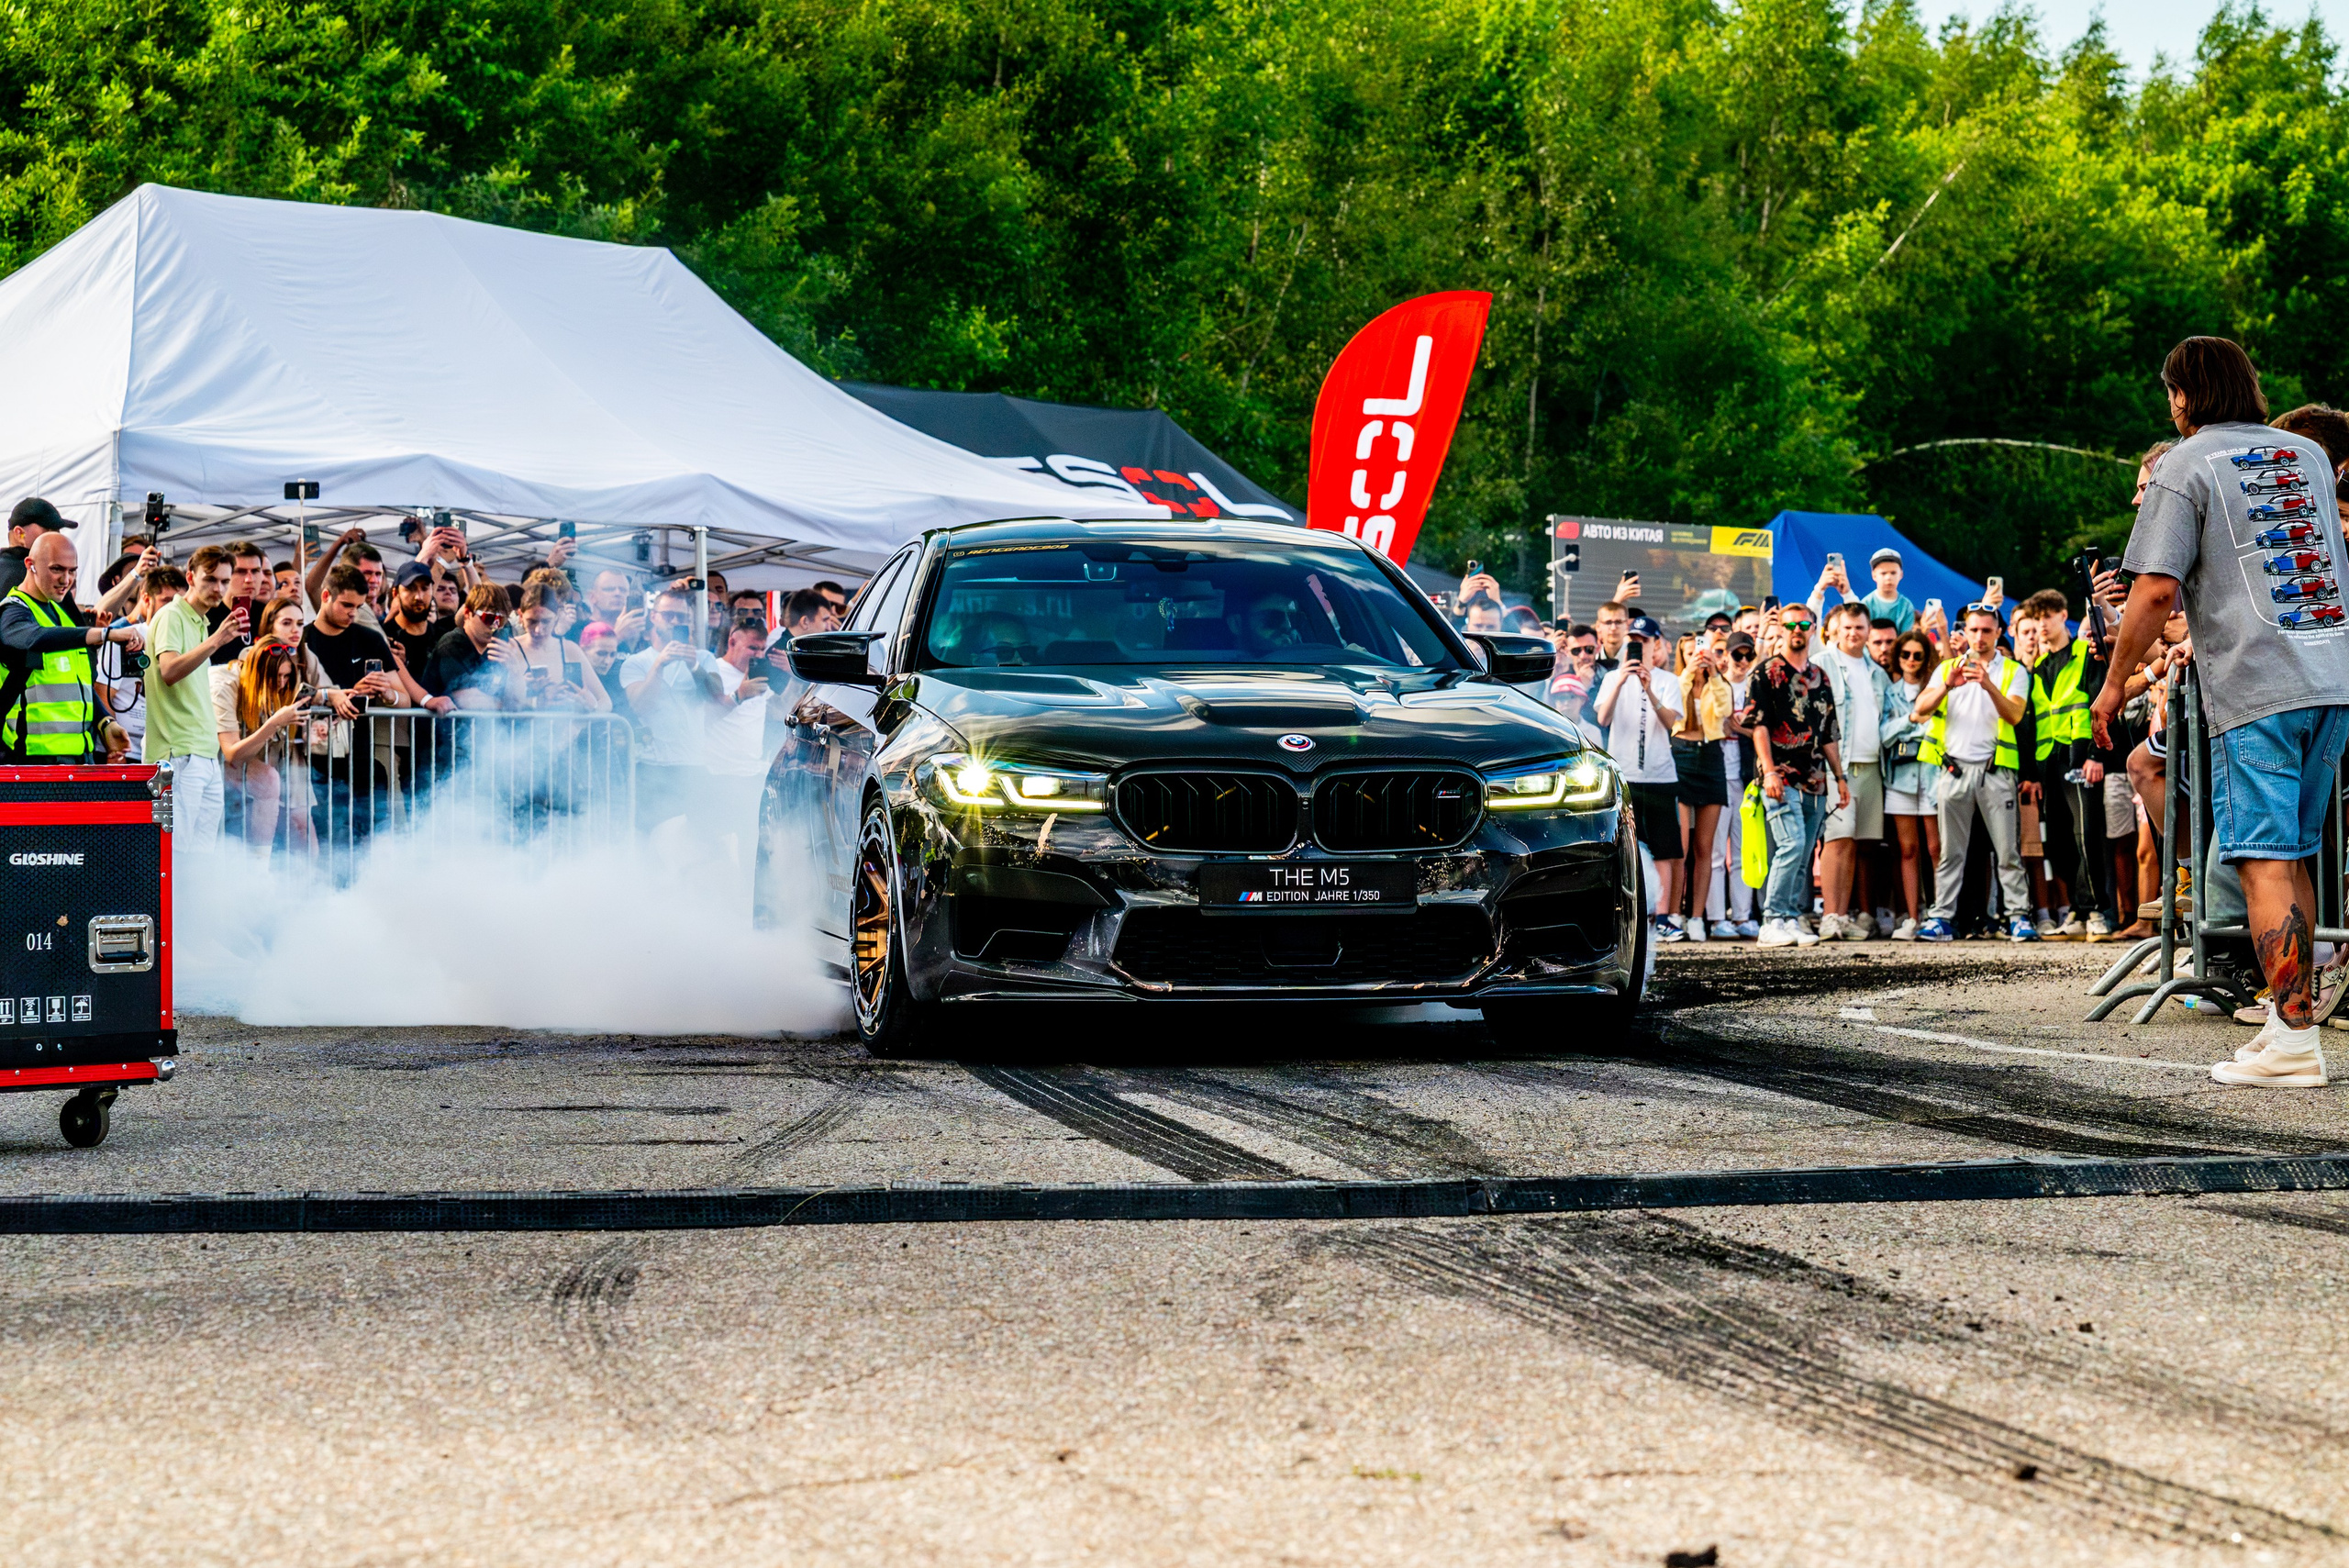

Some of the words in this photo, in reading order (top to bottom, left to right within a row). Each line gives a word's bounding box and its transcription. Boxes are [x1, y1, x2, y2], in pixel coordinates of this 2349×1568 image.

[984, 453, 1295, 521] SOL
[1583, 523, 1612, 539] АВТО
[1612, 526, 1628, 540] ИЗ
[1628, 528, 1664, 543] КИТАЯ
[9, 853, 84, 865] GLOSHINE
[1269, 868, 1314, 886] THE
[1320, 868, 1350, 886] M5
[1266, 891, 1309, 902] EDITION
[1314, 891, 1350, 902] JAHRE
[1353, 889, 1380, 902] 1/350
[26, 932, 52, 951] 014
